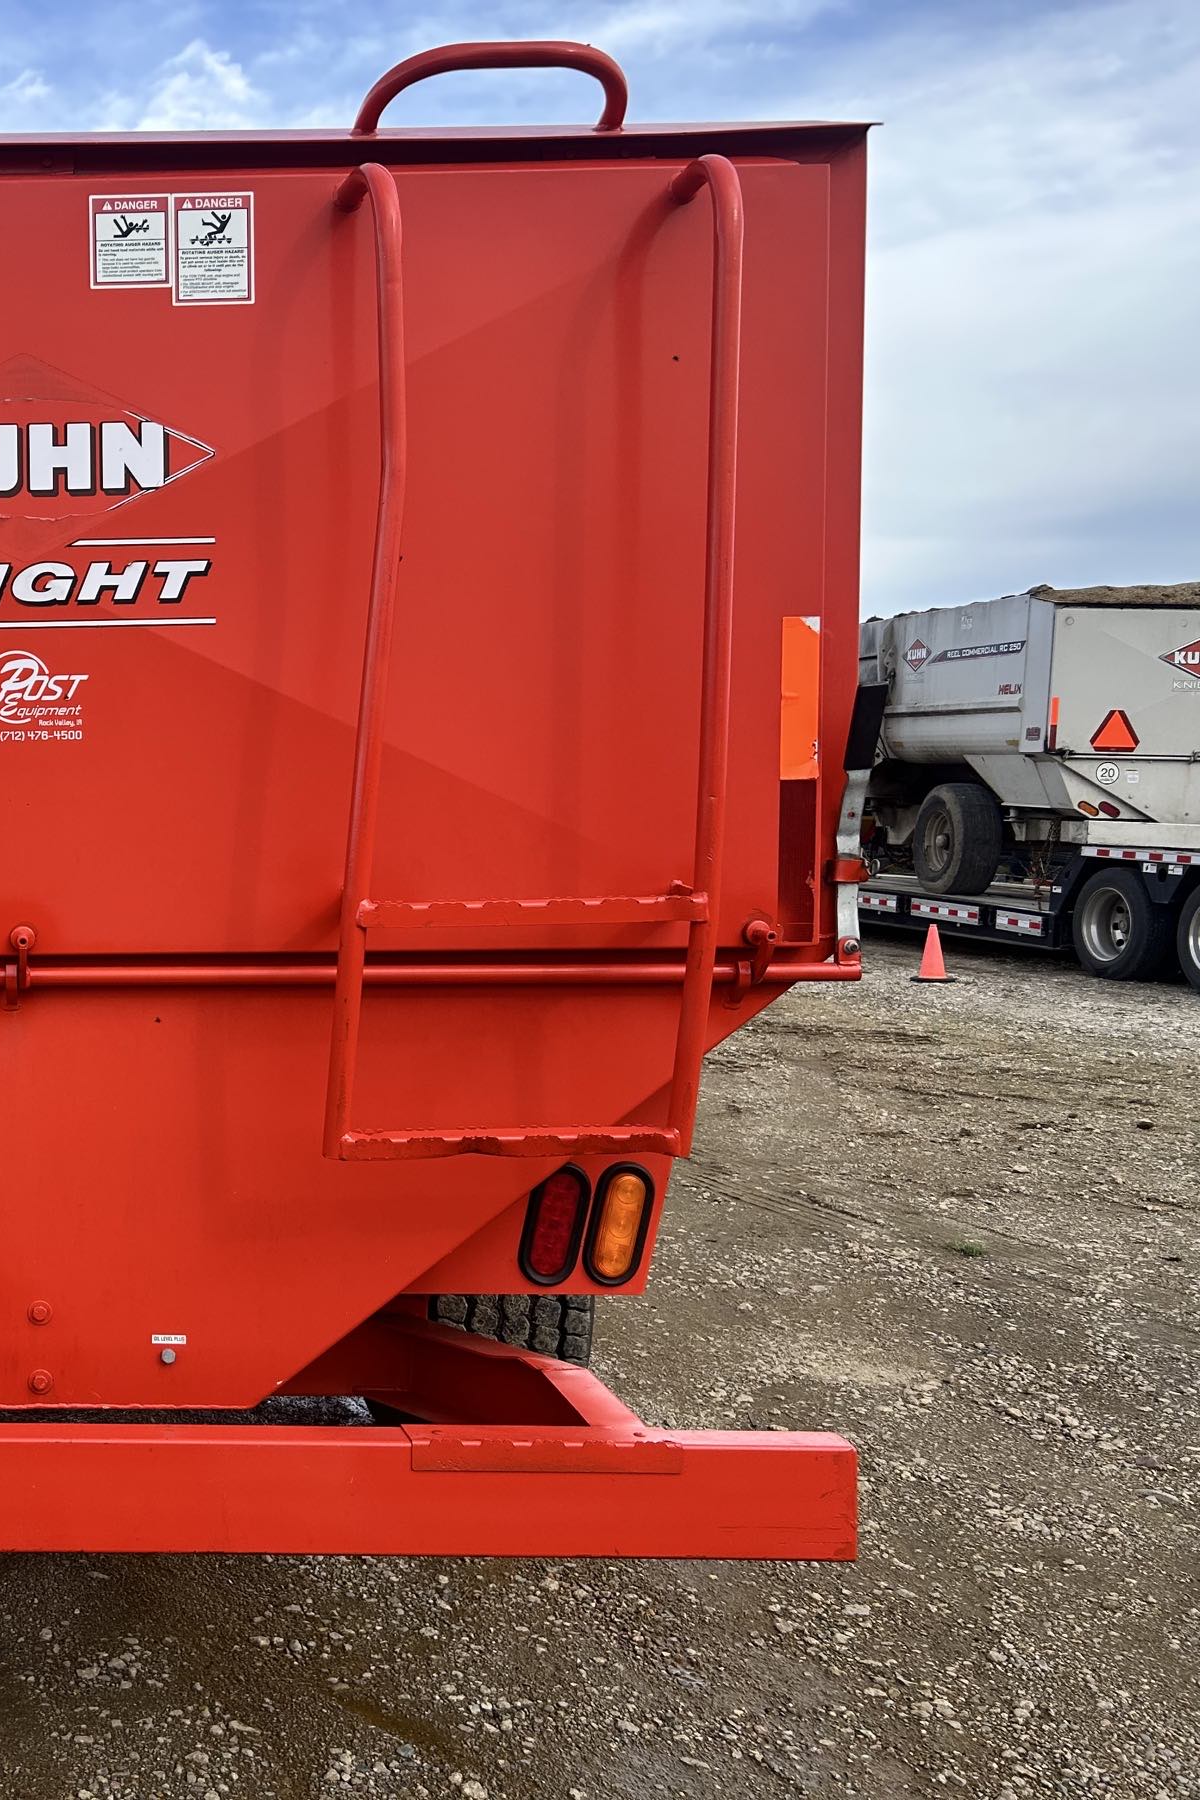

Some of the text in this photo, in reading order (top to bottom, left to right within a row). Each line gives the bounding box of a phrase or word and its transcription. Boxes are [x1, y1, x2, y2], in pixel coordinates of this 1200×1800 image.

[114, 200, 158, 210] DANGER
[196, 198, 242, 208] DANGER
[906, 648, 926, 660] KUHN
[962, 646, 998, 656] COMMERCIAL
[1009, 642, 1021, 650] 250
[998, 684, 1022, 695] HELIX
[0, 692, 82, 718] Equipment
[55, 719, 75, 727] Valley,
[0, 731, 82, 742] (712) 476-4500
[1101, 768, 1115, 777] 20
